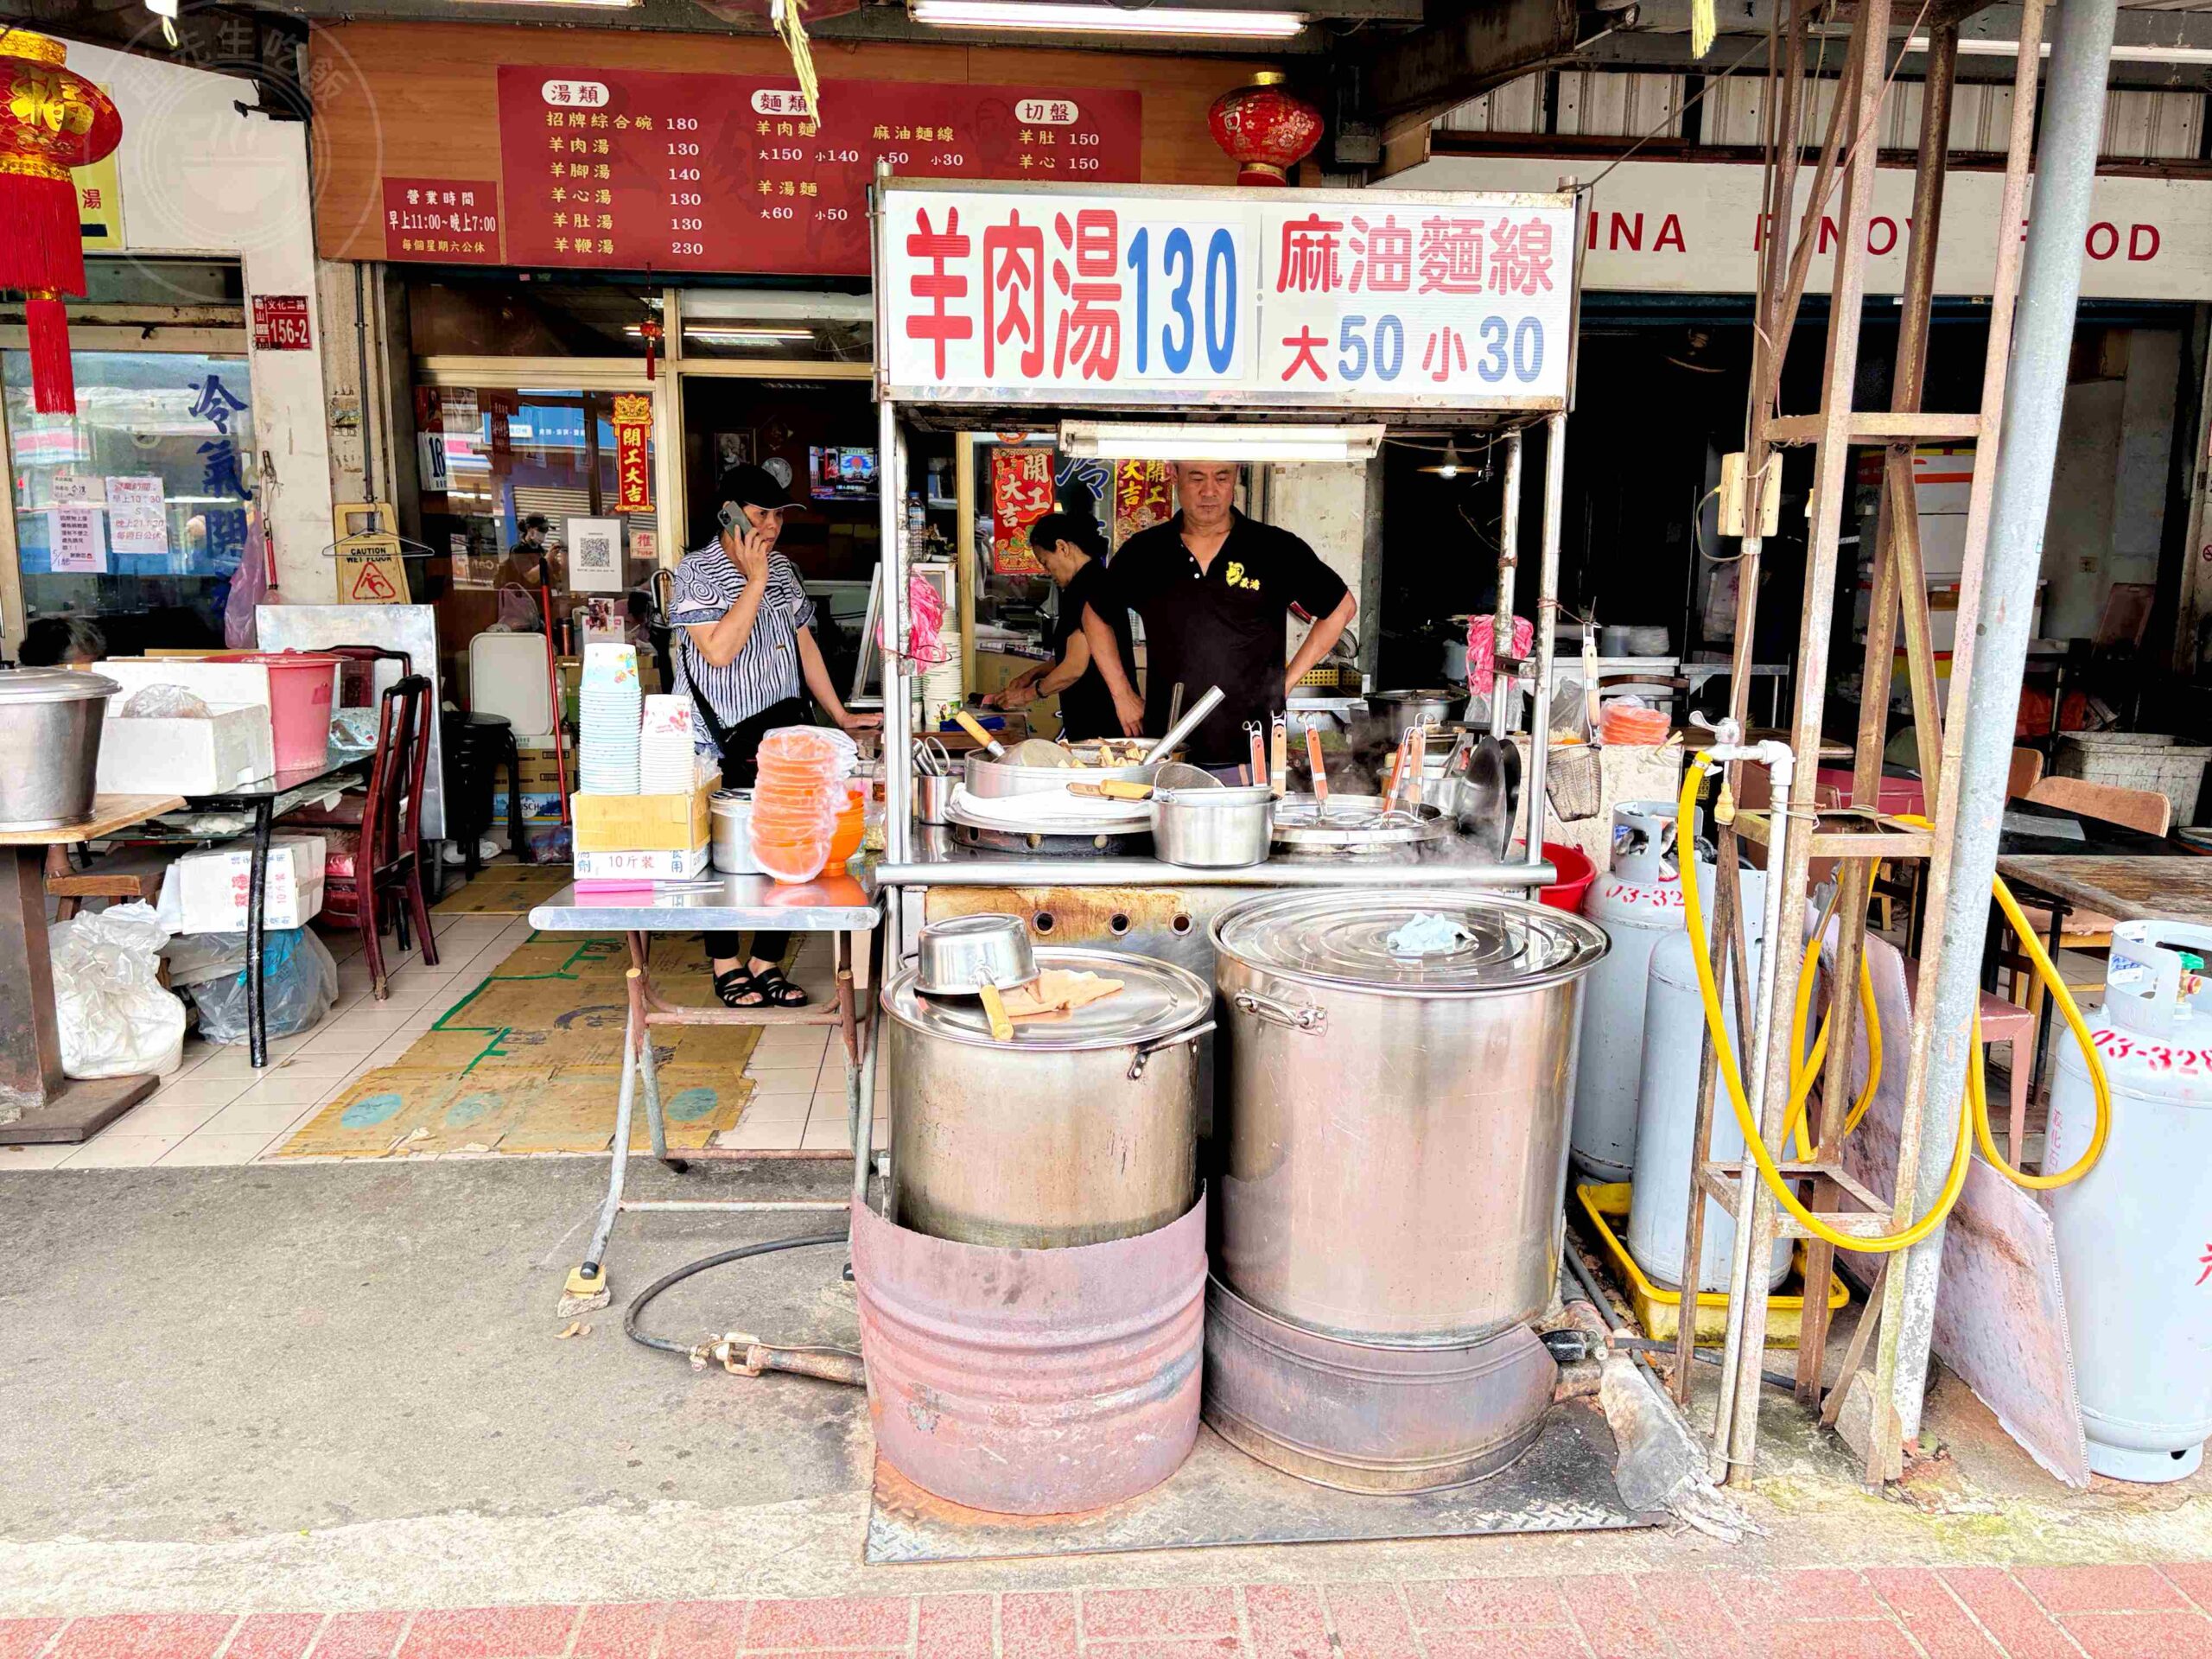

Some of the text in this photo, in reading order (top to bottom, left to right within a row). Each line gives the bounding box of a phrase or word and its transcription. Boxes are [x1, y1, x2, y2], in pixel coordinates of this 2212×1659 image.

[550, 85, 599, 104] 湯類
[760, 93, 808, 112] 麵類
[546, 111, 698, 130] 招牌綜合碗 180
[1025, 104, 1070, 122] 切盤
[755, 120, 816, 137] 羊肉麵
[873, 124, 954, 142] 麻油麵線
[1019, 130, 1099, 145] 羊肚 150
[549, 137, 699, 156] 羊肉湯 130
[1019, 154, 1099, 170] 羊心 150
[550, 162, 701, 181] 羊腳湯 140
[407, 188, 474, 207] 營業時間
[550, 188, 702, 206] 羊心湯 130
[757, 180, 817, 197] 羊湯麵
[553, 213, 702, 231] 羊肚湯 130
[403, 238, 486, 253] 每個星期六公休
[553, 238, 703, 255] 羊鞭湯 230
[1276, 213, 1554, 296] 麻油麵線
[906, 207, 1236, 381] 羊肉湯 130
[270, 318, 308, 344] 156-2
[623, 427, 645, 503] 開工大吉
[351, 547, 386, 556] CAUTION
[608, 855, 655, 869] 10斤裝
